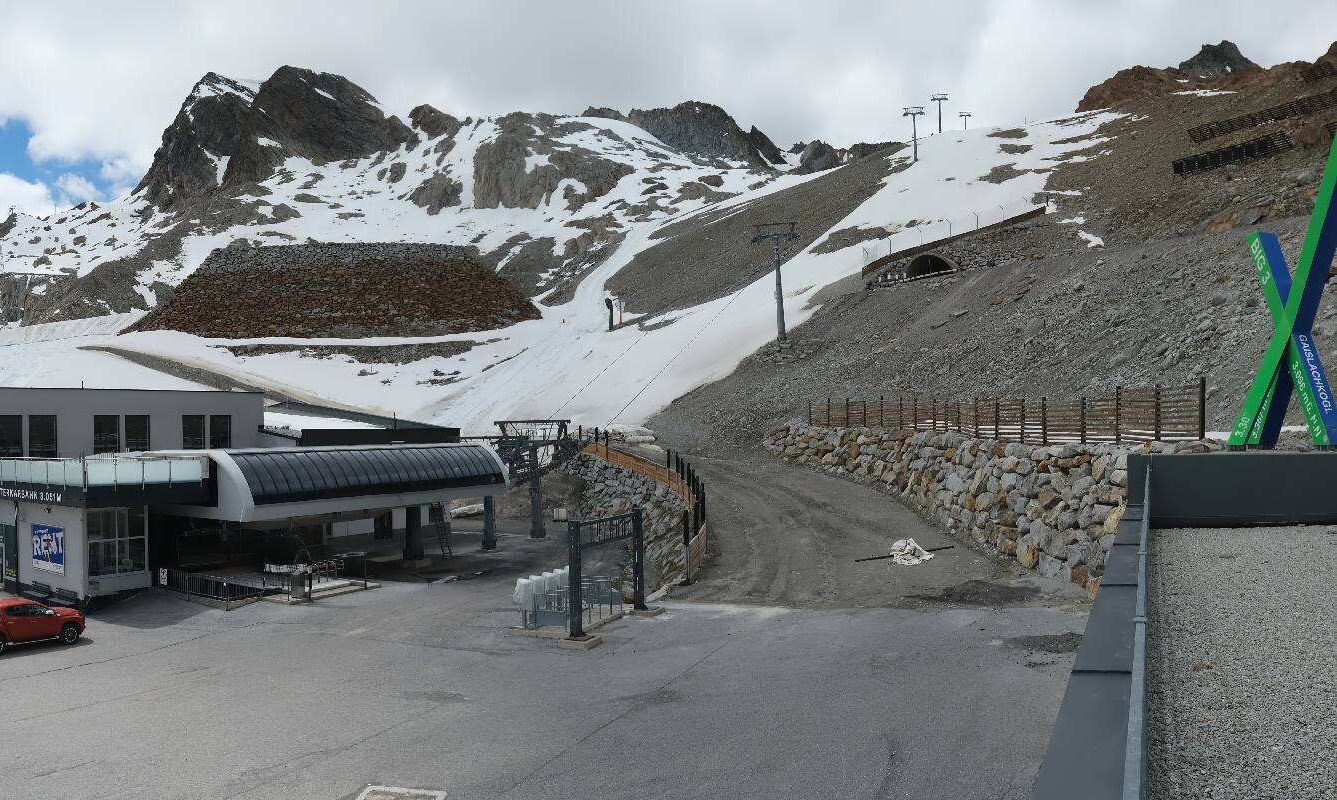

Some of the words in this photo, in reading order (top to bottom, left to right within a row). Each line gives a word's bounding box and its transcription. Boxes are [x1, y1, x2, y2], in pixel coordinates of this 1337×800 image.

[1251, 238, 1265, 271] BIG
[1262, 271, 1270, 284] 3
[1299, 334, 1332, 414] GAISLACHKOGL
